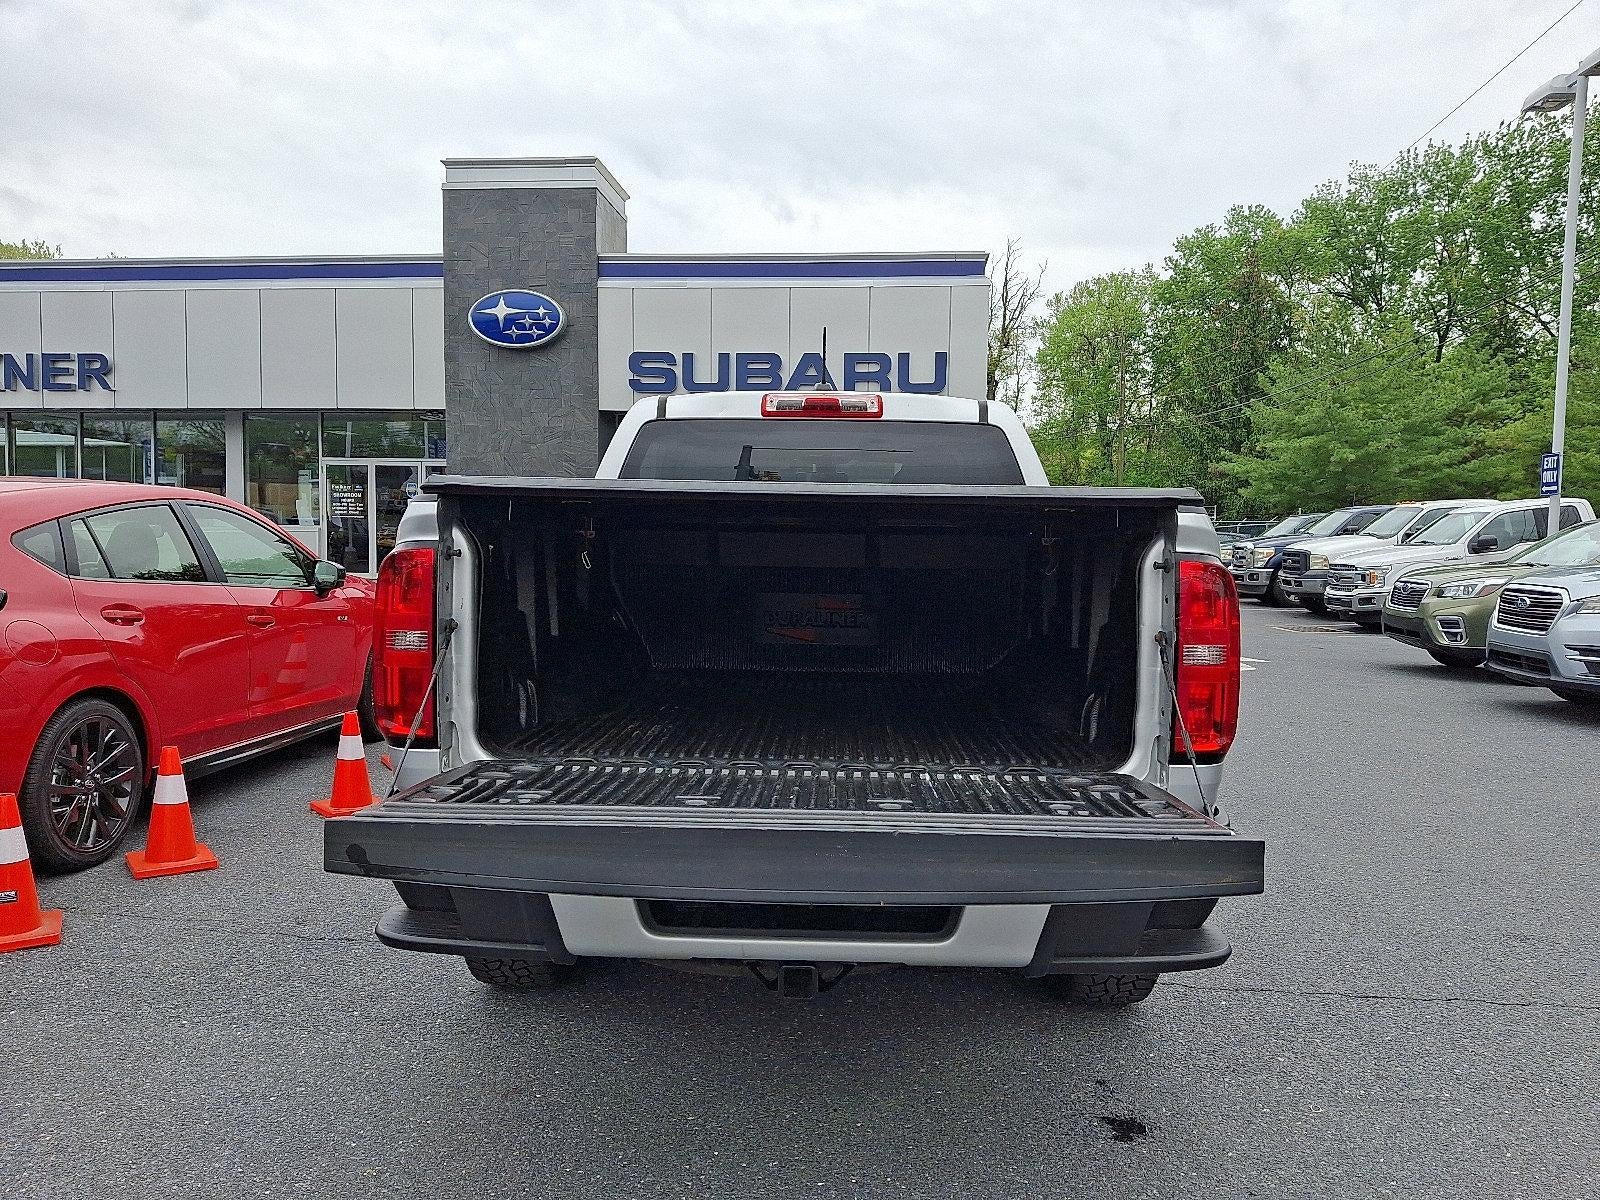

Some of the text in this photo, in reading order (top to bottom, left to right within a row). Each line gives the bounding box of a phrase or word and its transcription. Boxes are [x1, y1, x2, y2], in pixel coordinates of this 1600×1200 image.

[0, 353, 113, 391] NER
[628, 351, 948, 393] SUBARU
[1543, 457, 1557, 469] EXIT
[1542, 470, 1557, 483] ONLY
